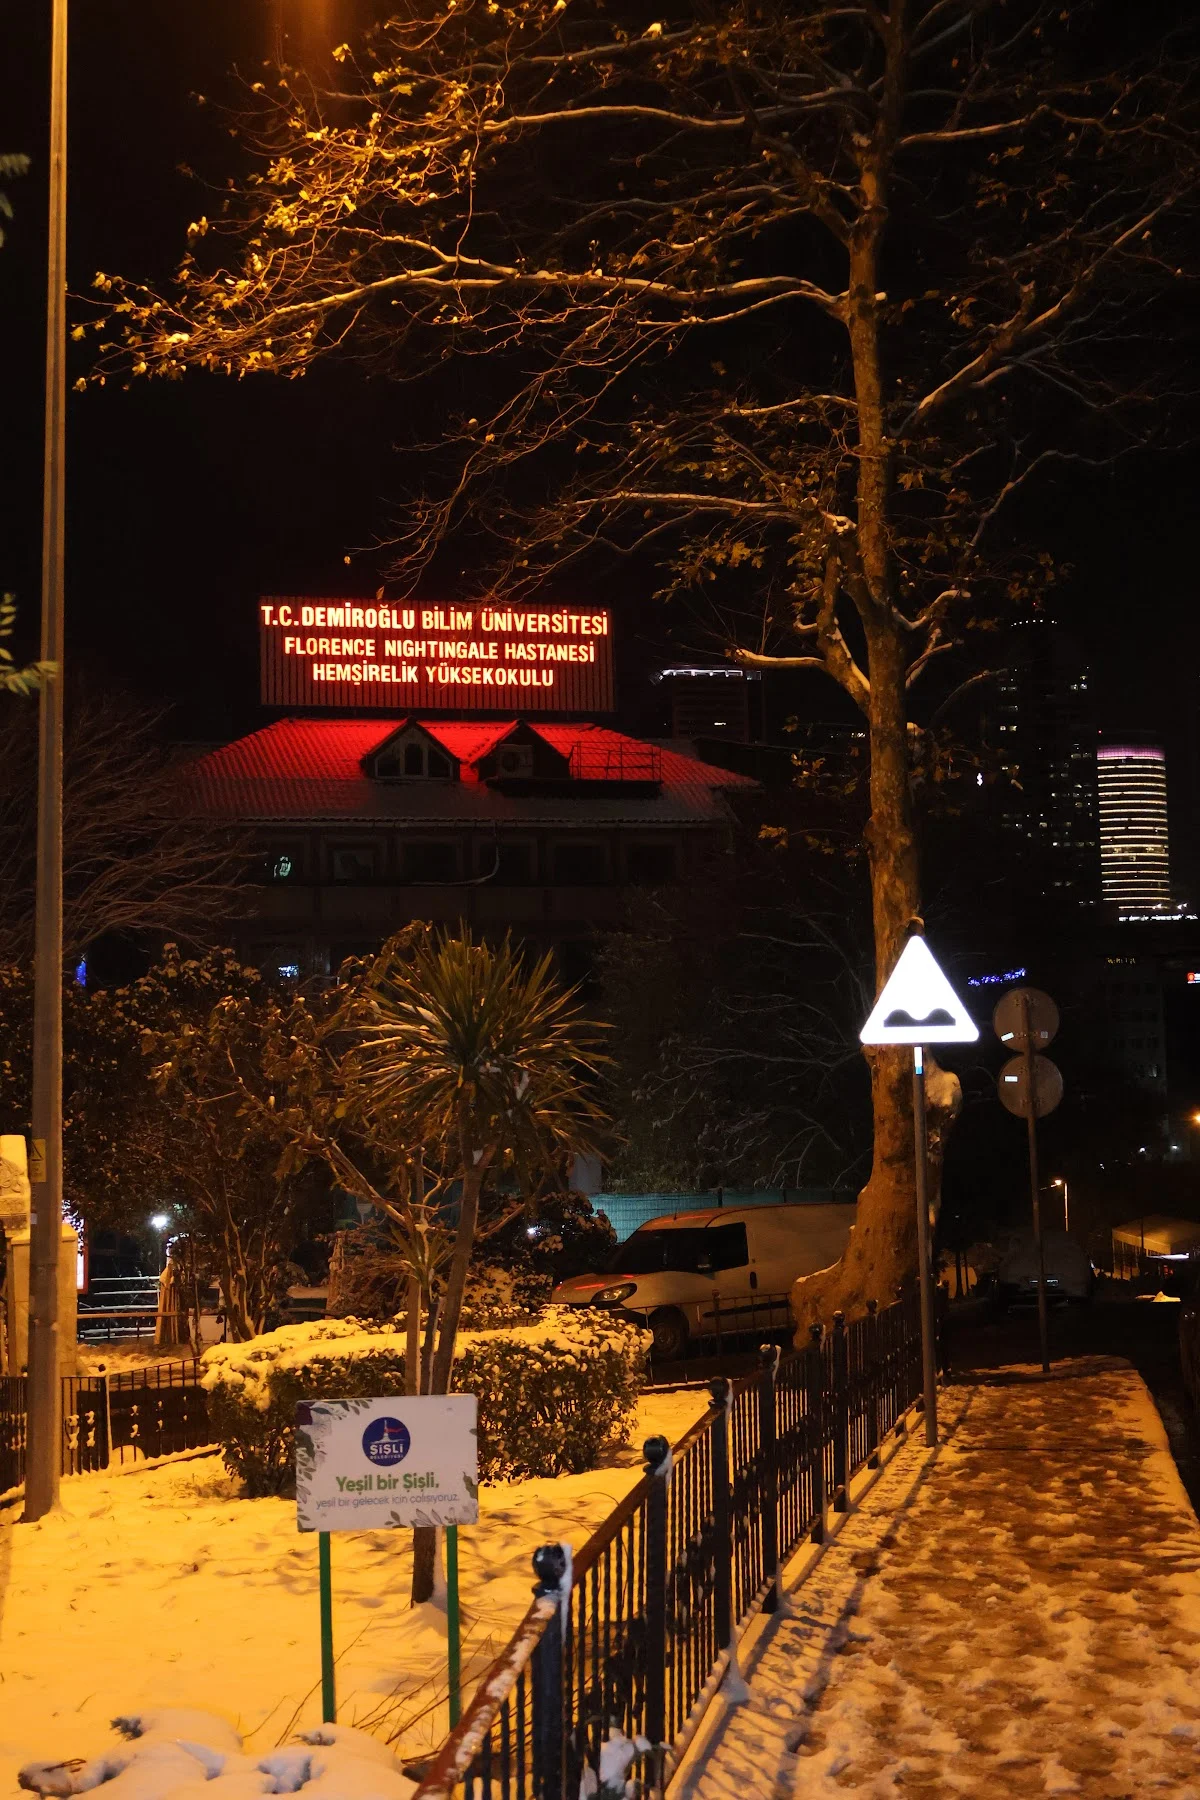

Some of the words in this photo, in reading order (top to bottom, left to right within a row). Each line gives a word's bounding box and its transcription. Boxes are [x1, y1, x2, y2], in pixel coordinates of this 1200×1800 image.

[422, 605, 473, 631] BİLİM
[481, 607, 608, 636] ÜNİVERSİTESİ
[284, 637, 376, 657] FLORENCE
[384, 639, 499, 660] NIGHTINGALE
[504, 641, 595, 663] HASTANESİ
[313, 660, 418, 686] HEMŞİRELİK
[425, 662, 554, 687] YÜKSEKOKULU
[370, 1443, 403, 1455] ŞİŞLİ
[335, 1474, 373, 1496] Yeşil
[376, 1473, 399, 1490] bir
[338, 1496, 350, 1508] bir
[352, 1496, 389, 1509] gelecek
